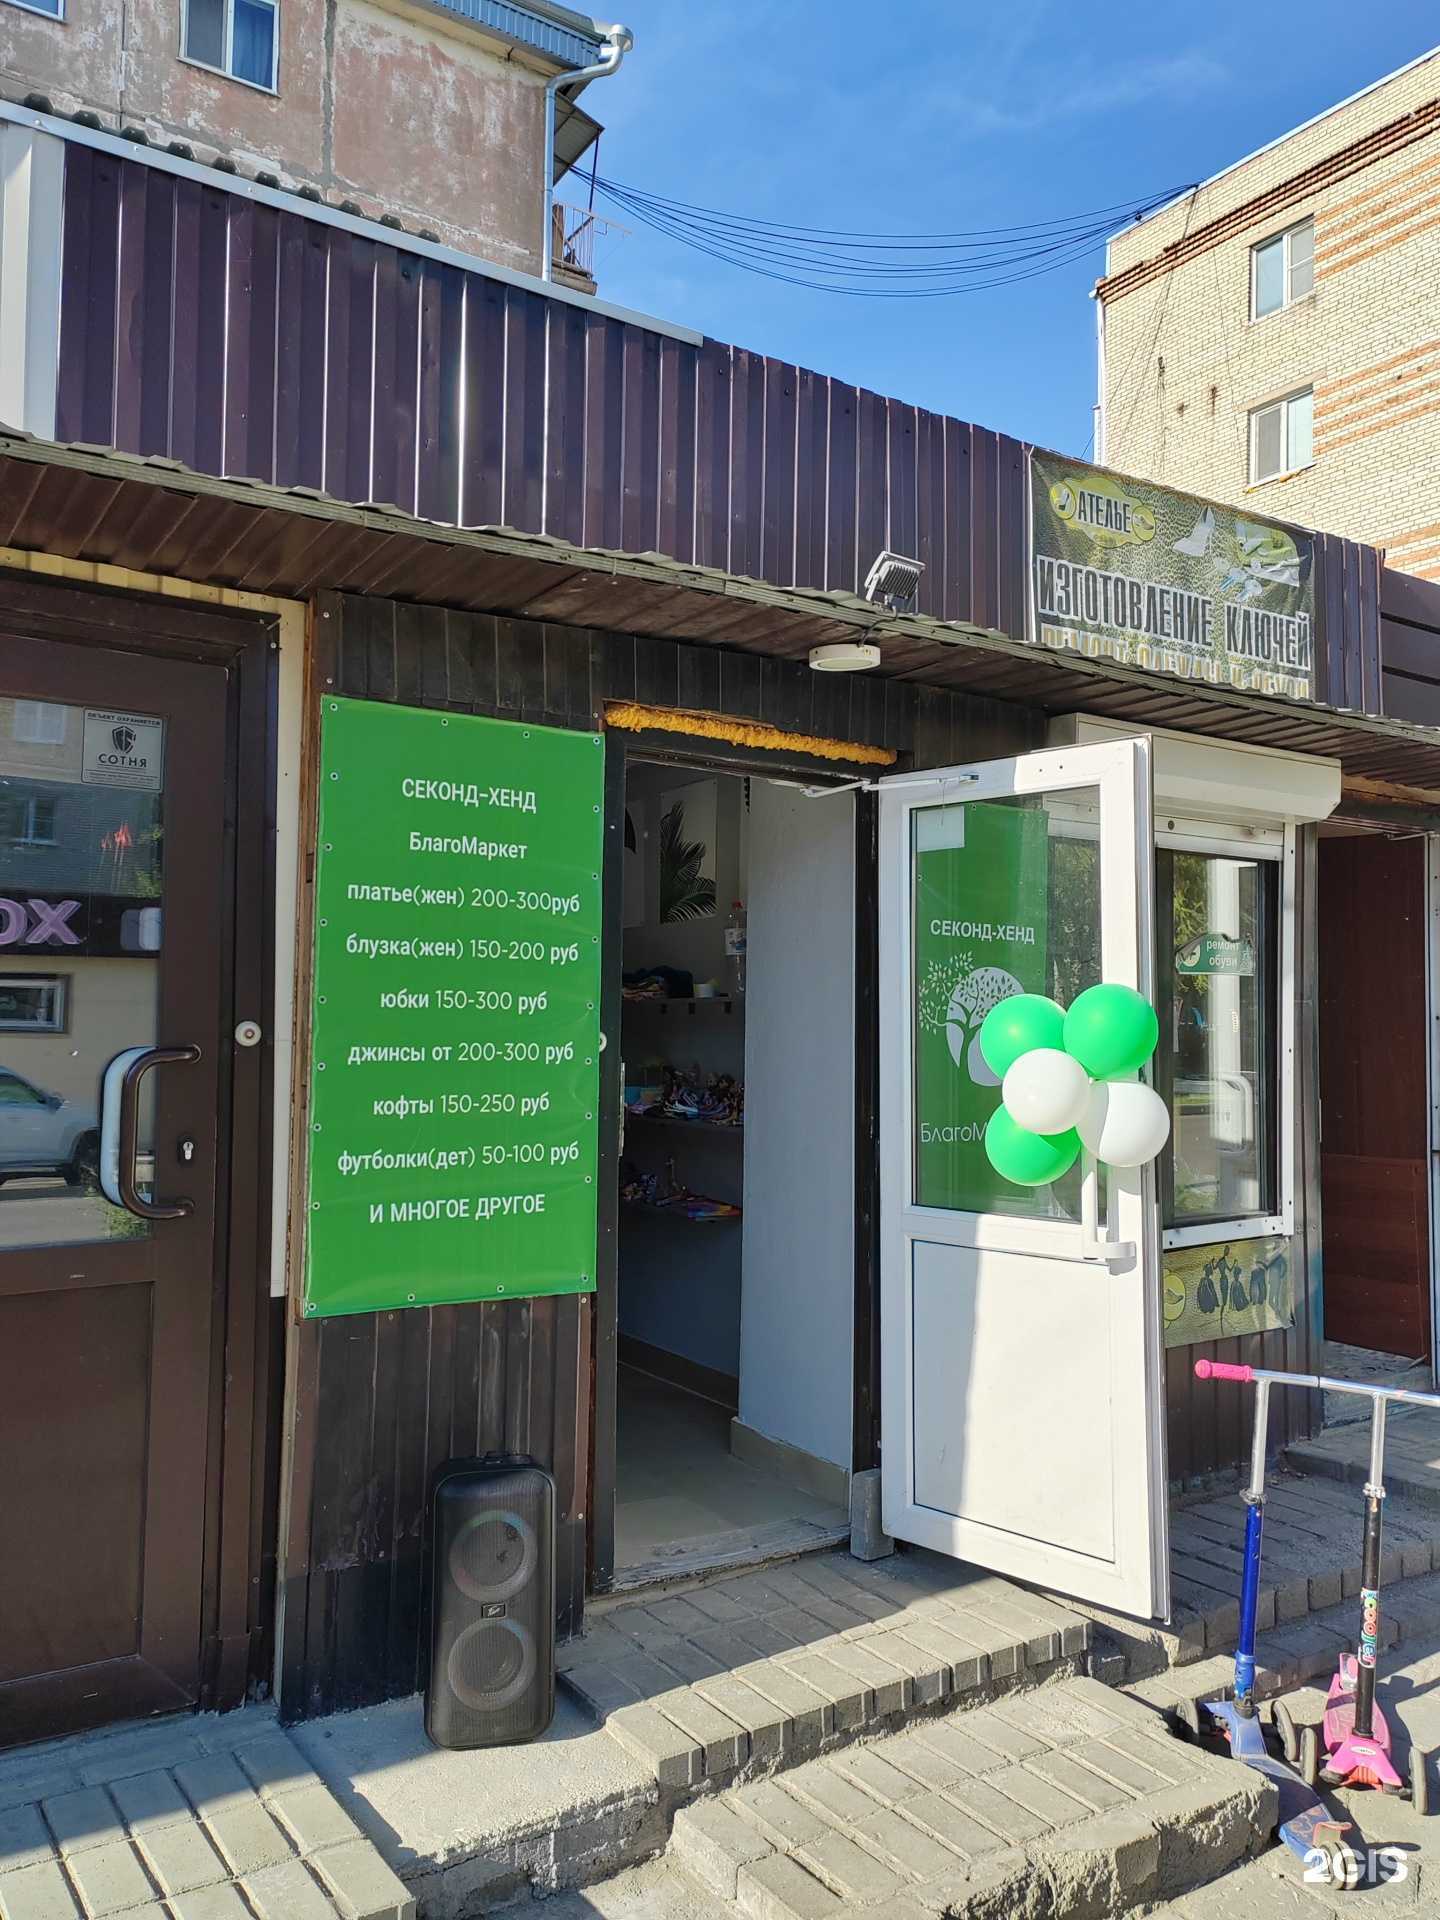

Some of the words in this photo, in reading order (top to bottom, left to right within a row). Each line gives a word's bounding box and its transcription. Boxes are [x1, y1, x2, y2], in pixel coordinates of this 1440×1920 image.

[1077, 489, 1131, 534] АТЕЛЬЕ
[1037, 555, 1214, 648] ИЗГОТОВЛЕНИЕ
[1224, 602, 1312, 671] КЛЮЧЕЙ
[98, 753, 148, 768] СОТНЯ
[403, 779, 536, 814] СЕКОНД-ХЕНД
[410, 832, 527, 860] БлагоМаркет
[348, 885, 464, 907] платье(жен)
[472, 888, 579, 916] 200-300руб
[930, 918, 1036, 945] СЕКОНД-ХЕНД
[347, 933, 463, 959] блузка(жен)
[470, 940, 544, 960] 150-200
[551, 943, 578, 965] руб
[381, 989, 428, 1008] юбки
[436, 991, 512, 1009] 150-300
[519, 992, 547, 1014] руб
[348, 1047, 424, 1064] джинсы
[432, 1047, 452, 1060] от
[458, 1043, 539, 1061] 200-300
[546, 1042, 573, 1064] руб
[374, 1095, 433, 1119] кофты
[441, 1094, 515, 1113] 150-250
[521, 1092, 549, 1116] руб
[338, 1147, 475, 1175] футболки(дет)
[483, 1144, 544, 1164] 50-100
[551, 1141, 578, 1165] руб
[370, 1204, 383, 1223] И
[391, 1199, 469, 1221] МНОГОЕ
[475, 1194, 545, 1220] ДРУГОЕ
